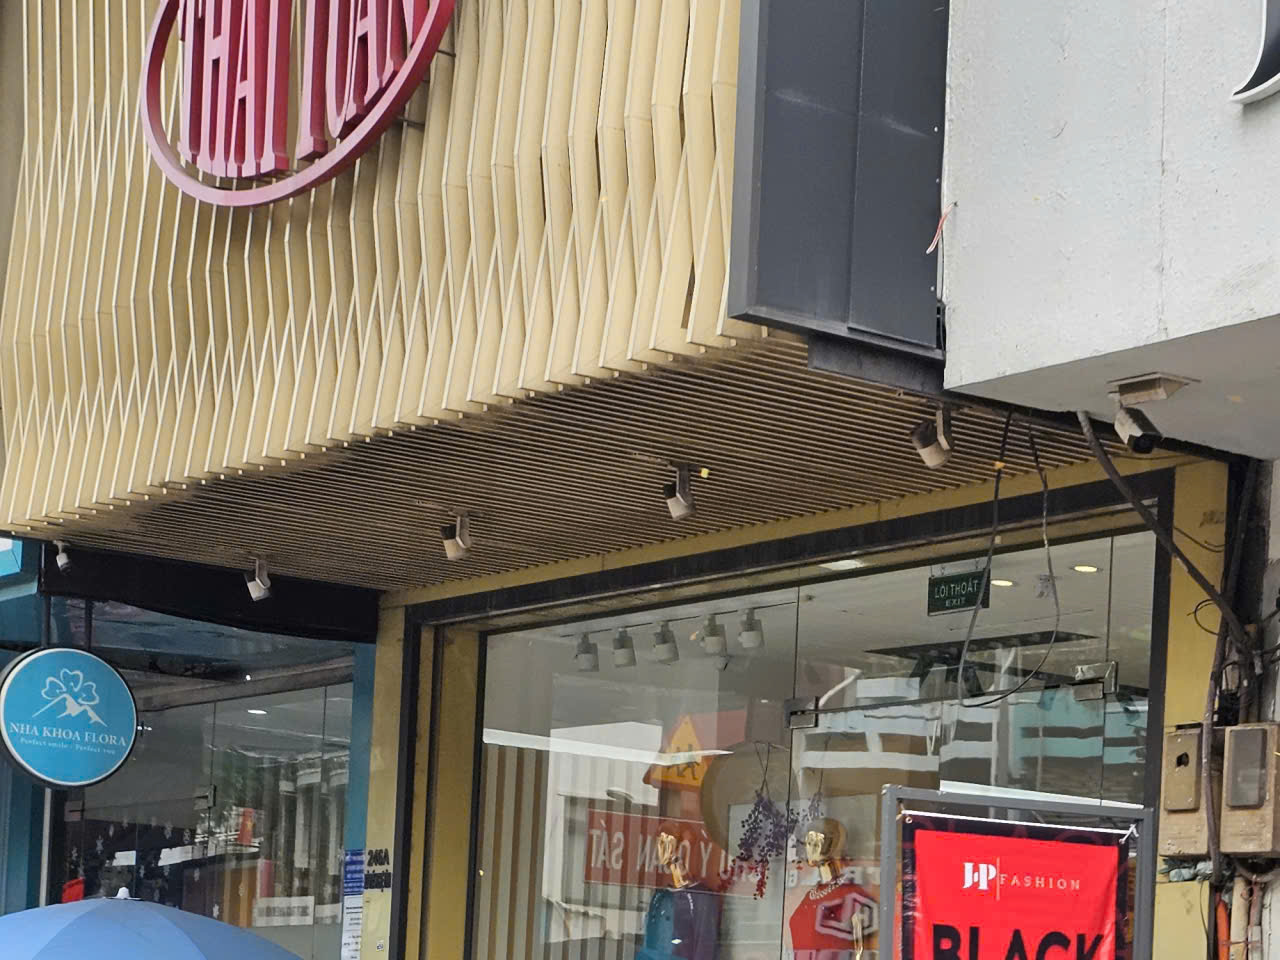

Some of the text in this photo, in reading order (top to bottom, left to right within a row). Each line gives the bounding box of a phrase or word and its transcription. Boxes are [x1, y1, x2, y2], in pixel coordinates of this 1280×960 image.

[42, 726, 81, 741] KHOA
[84, 731, 127, 747] FLORA
[999, 873, 1081, 891] FASHION
